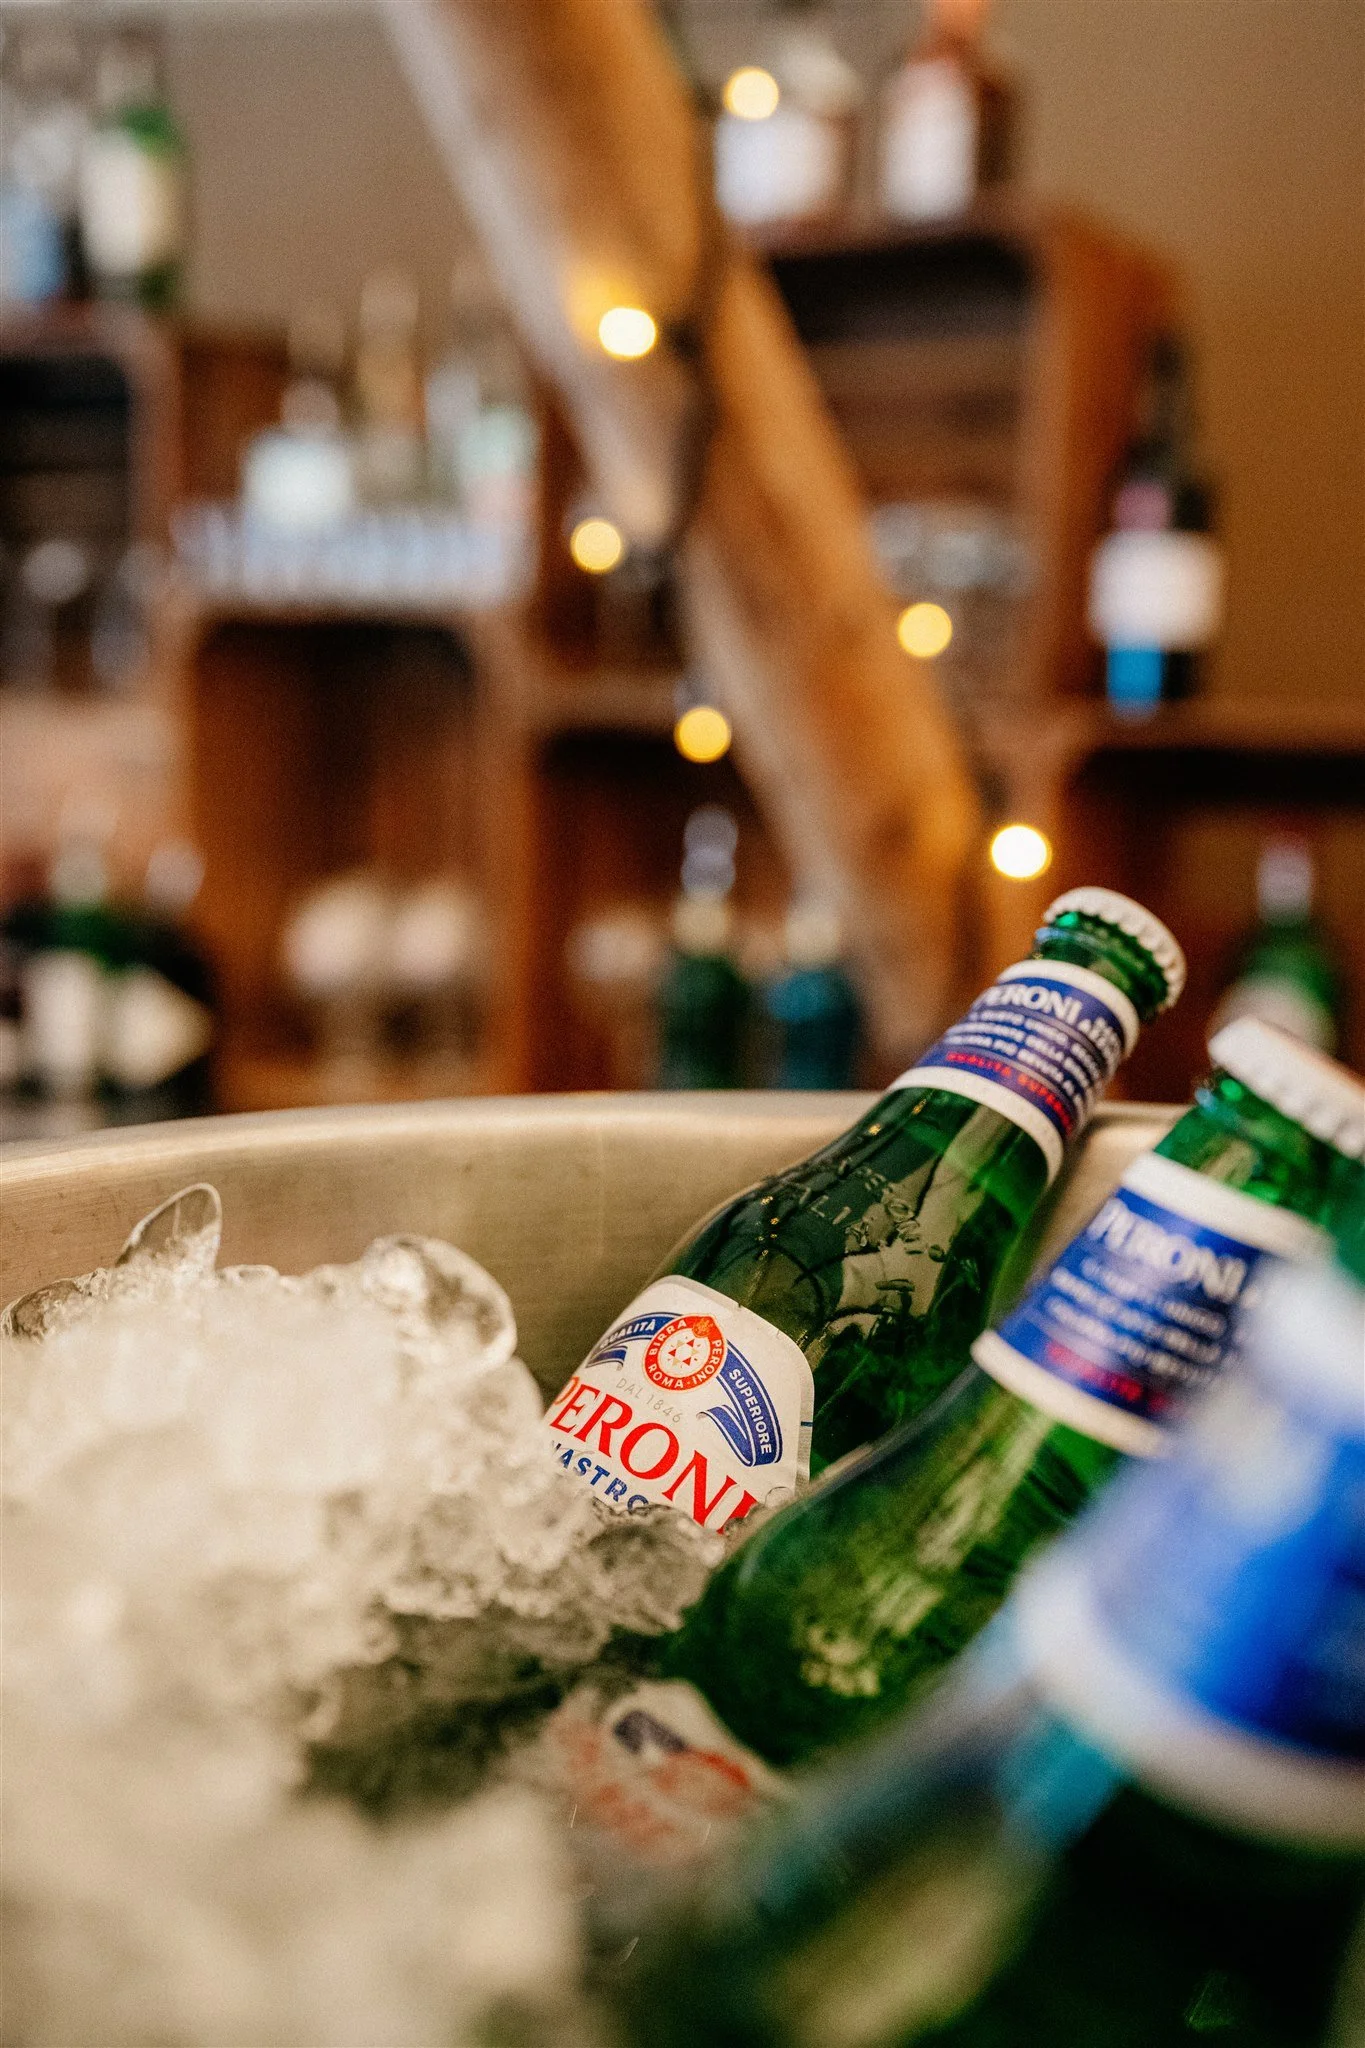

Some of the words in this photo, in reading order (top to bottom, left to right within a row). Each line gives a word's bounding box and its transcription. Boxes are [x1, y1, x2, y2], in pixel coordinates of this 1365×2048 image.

[647, 1362, 685, 1390] ROMA
[649, 1320, 687, 1356] BIRRA
[691, 1339, 723, 1385] PERONI
[616, 1378, 641, 1400] DAL
[646, 1394, 684, 1424] 1846
[728, 1368, 772, 1455] SUPERIORE
